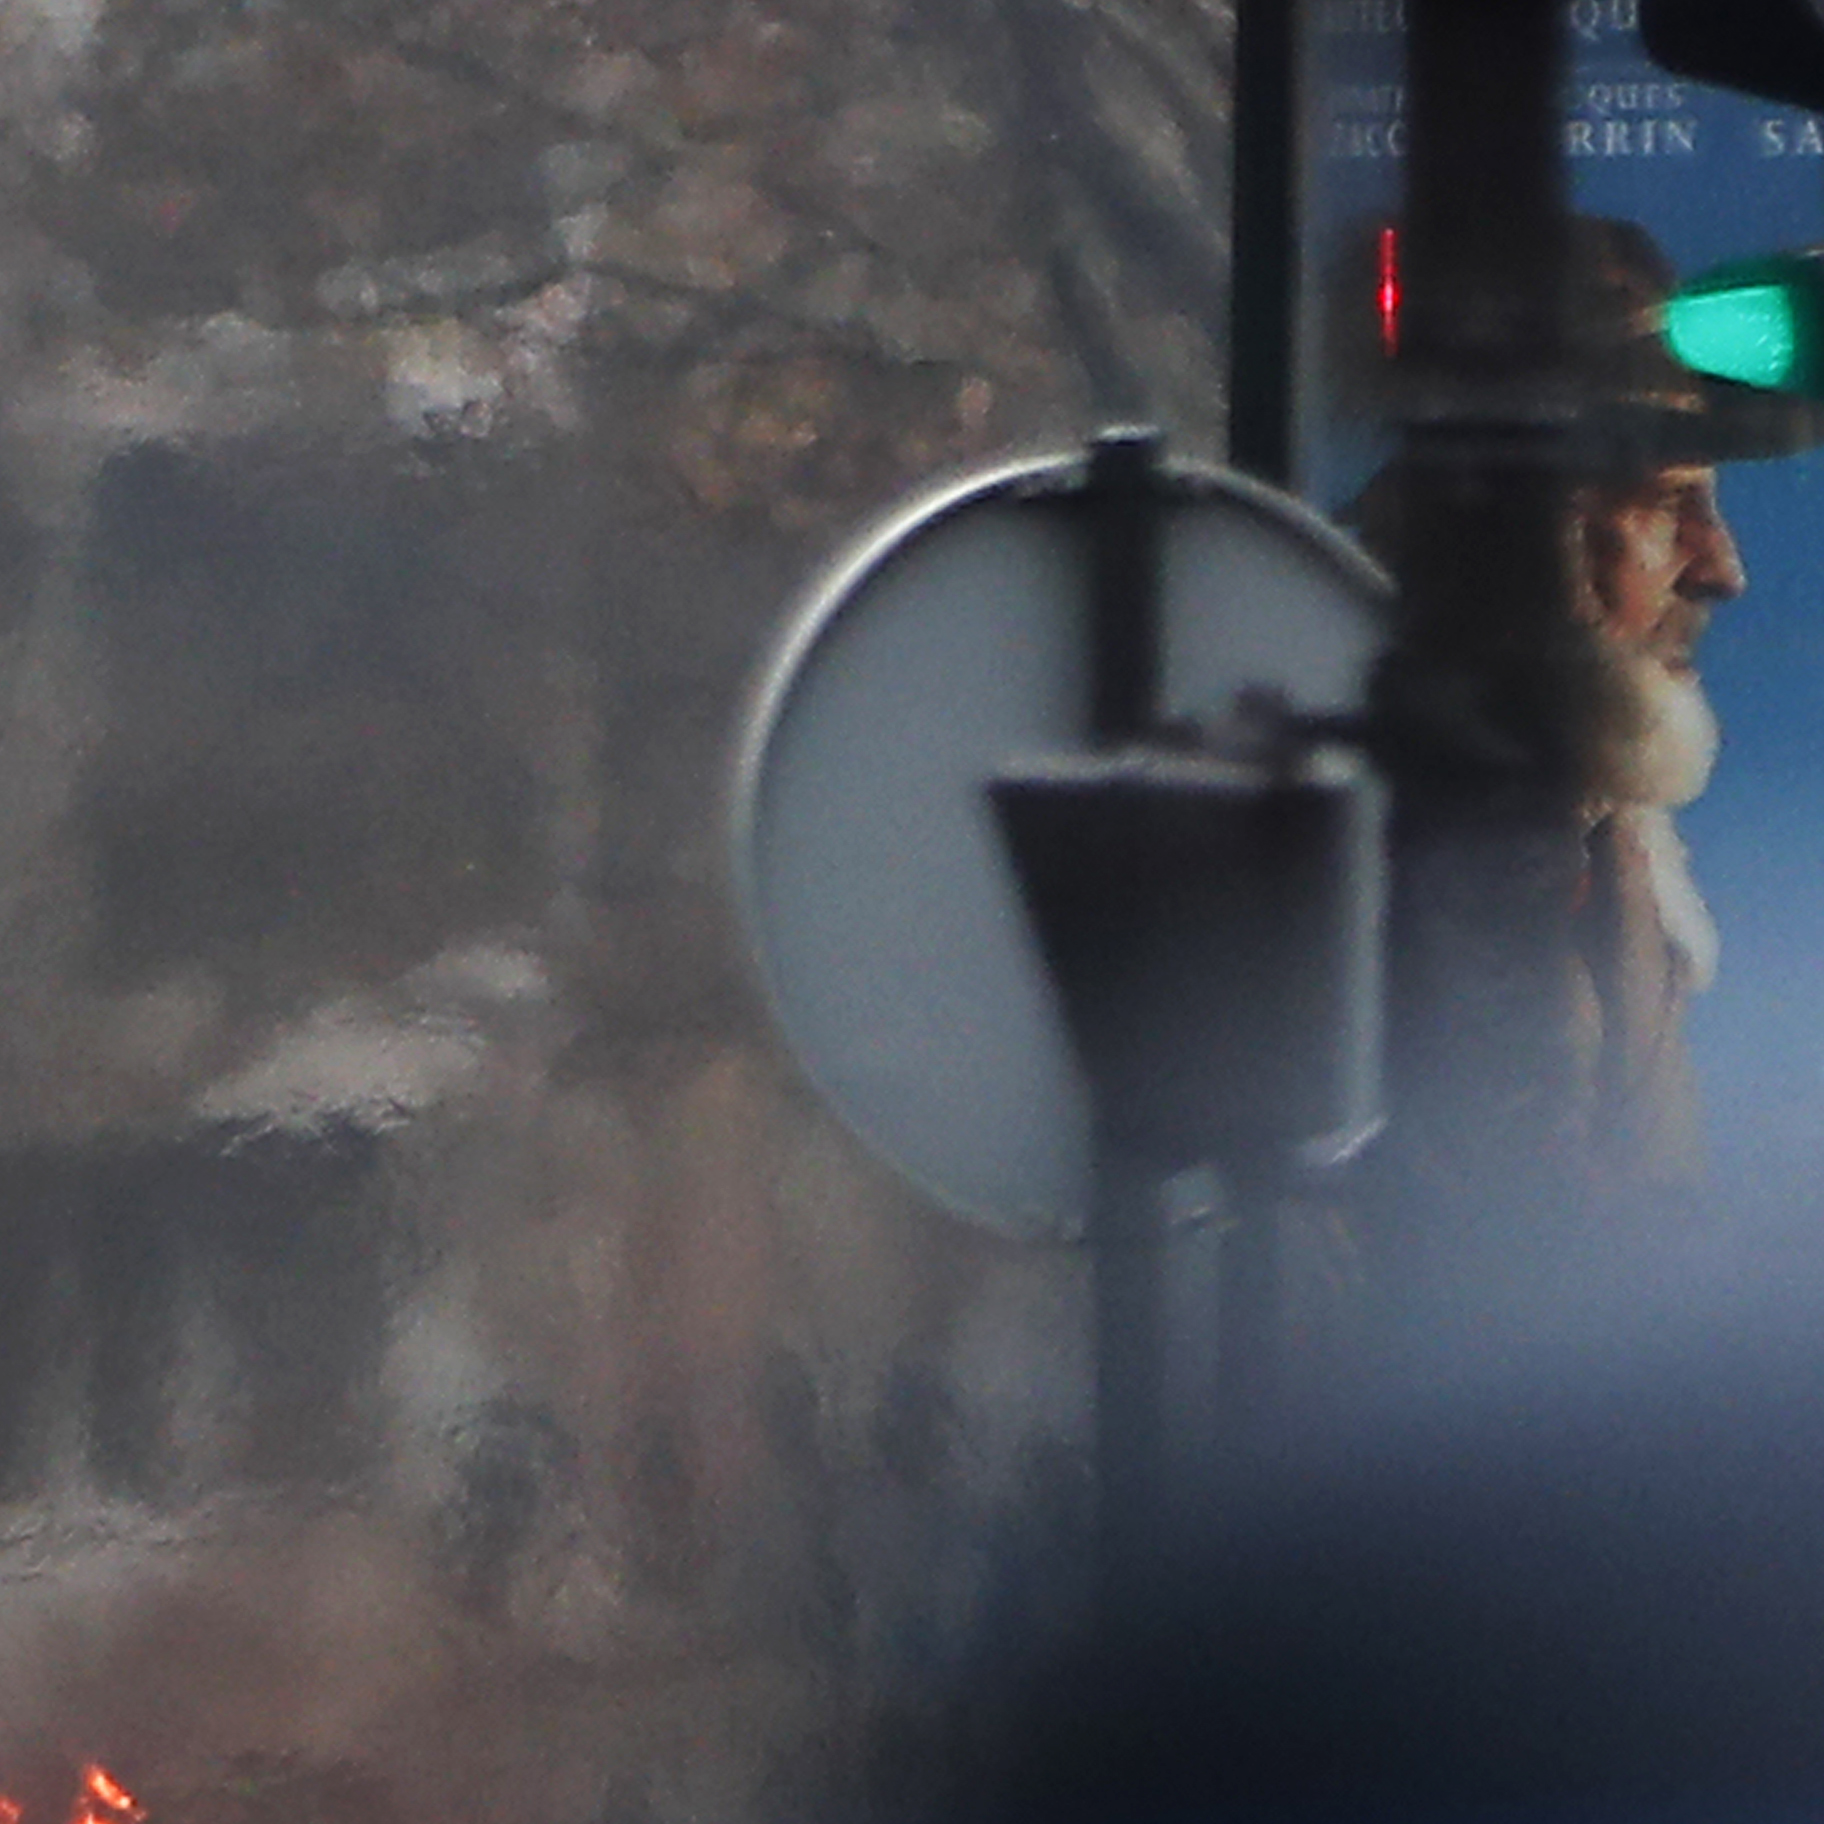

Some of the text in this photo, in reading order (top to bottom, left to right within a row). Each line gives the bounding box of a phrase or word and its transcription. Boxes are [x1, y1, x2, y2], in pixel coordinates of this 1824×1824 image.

[1570, 0, 1639, 40] QU
[1587, 82, 1687, 116] QUES
[1567, 119, 1698, 156] RRIN
